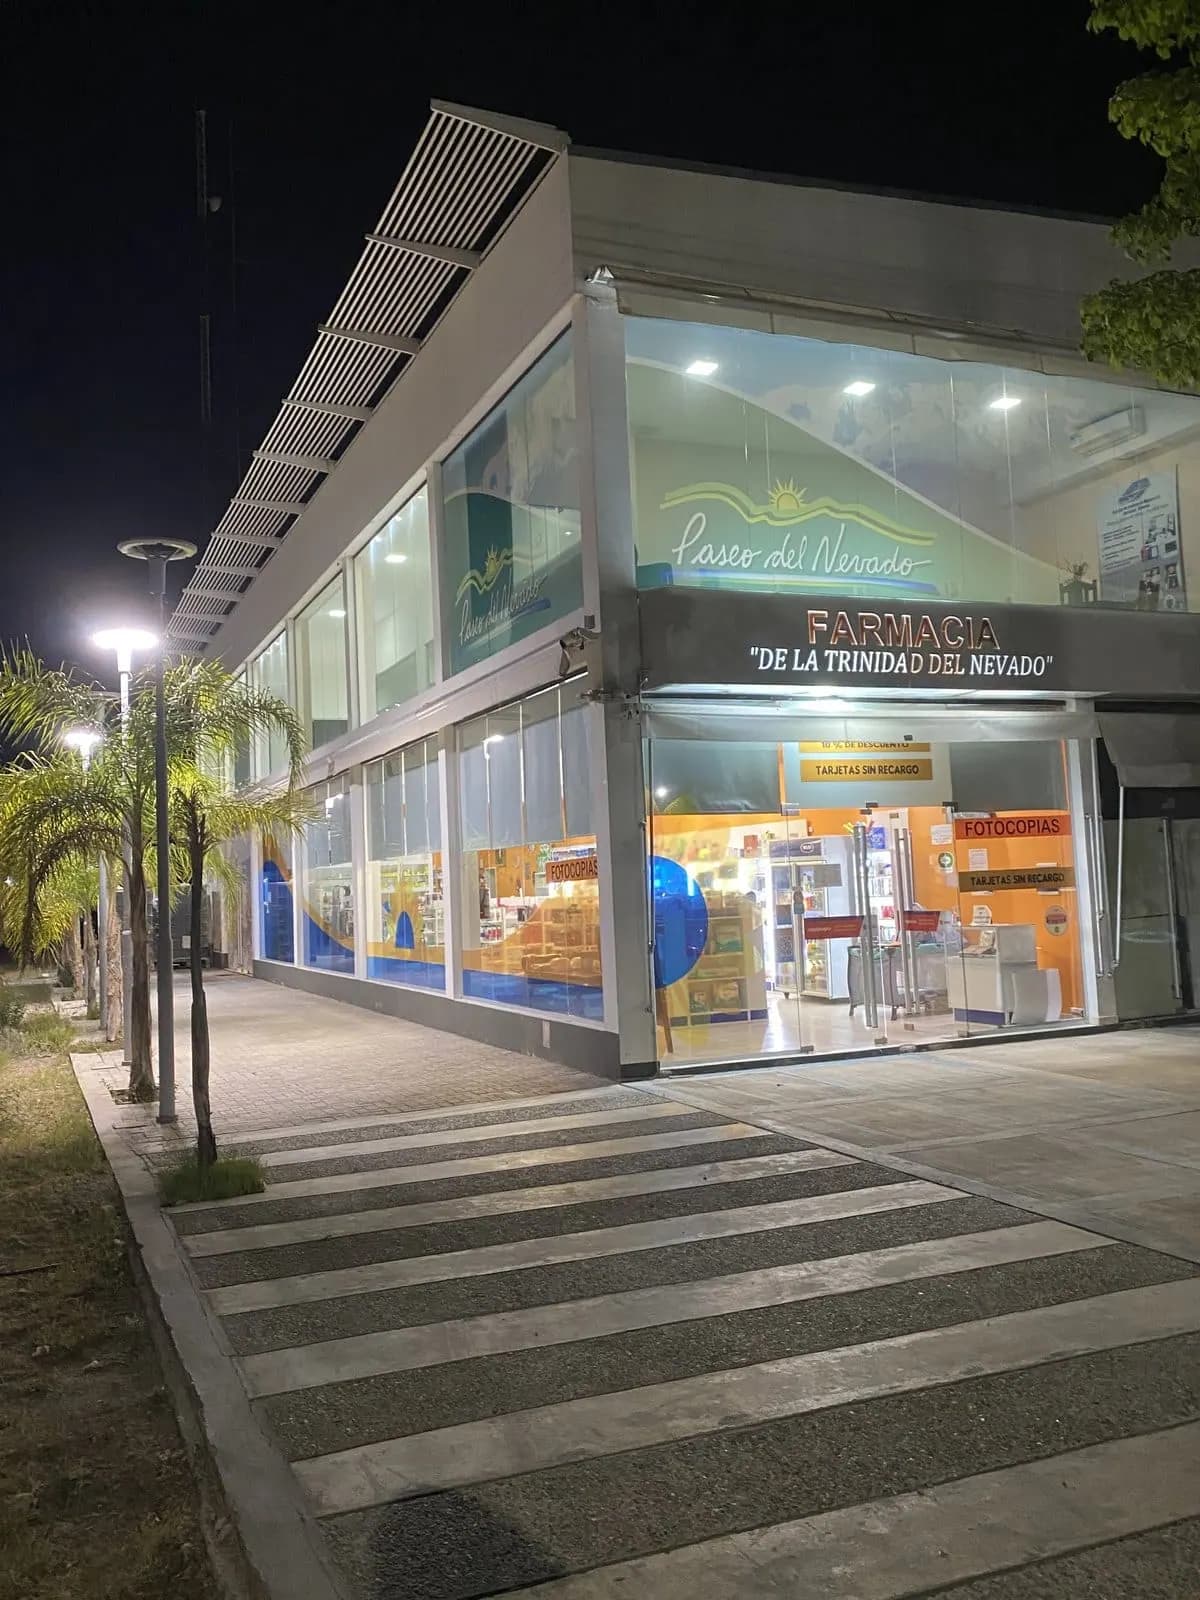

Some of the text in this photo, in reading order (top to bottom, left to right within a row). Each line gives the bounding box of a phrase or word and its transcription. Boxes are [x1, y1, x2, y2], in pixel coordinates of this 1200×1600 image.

[672, 511, 932, 576] Paseo del Nevado
[807, 609, 1000, 650] FARMACIA
[750, 646, 1054, 677] "DE LA TRINIDAD DEL NEVADO"
[815, 764, 920, 776] TARJETAS SIN RECARGO
[965, 818, 1060, 836] FOTOCOPIAS
[551, 859, 598, 880] FOTOCOPIAS
[970, 872, 1065, 886] TARJETAS SIN RECARGO
